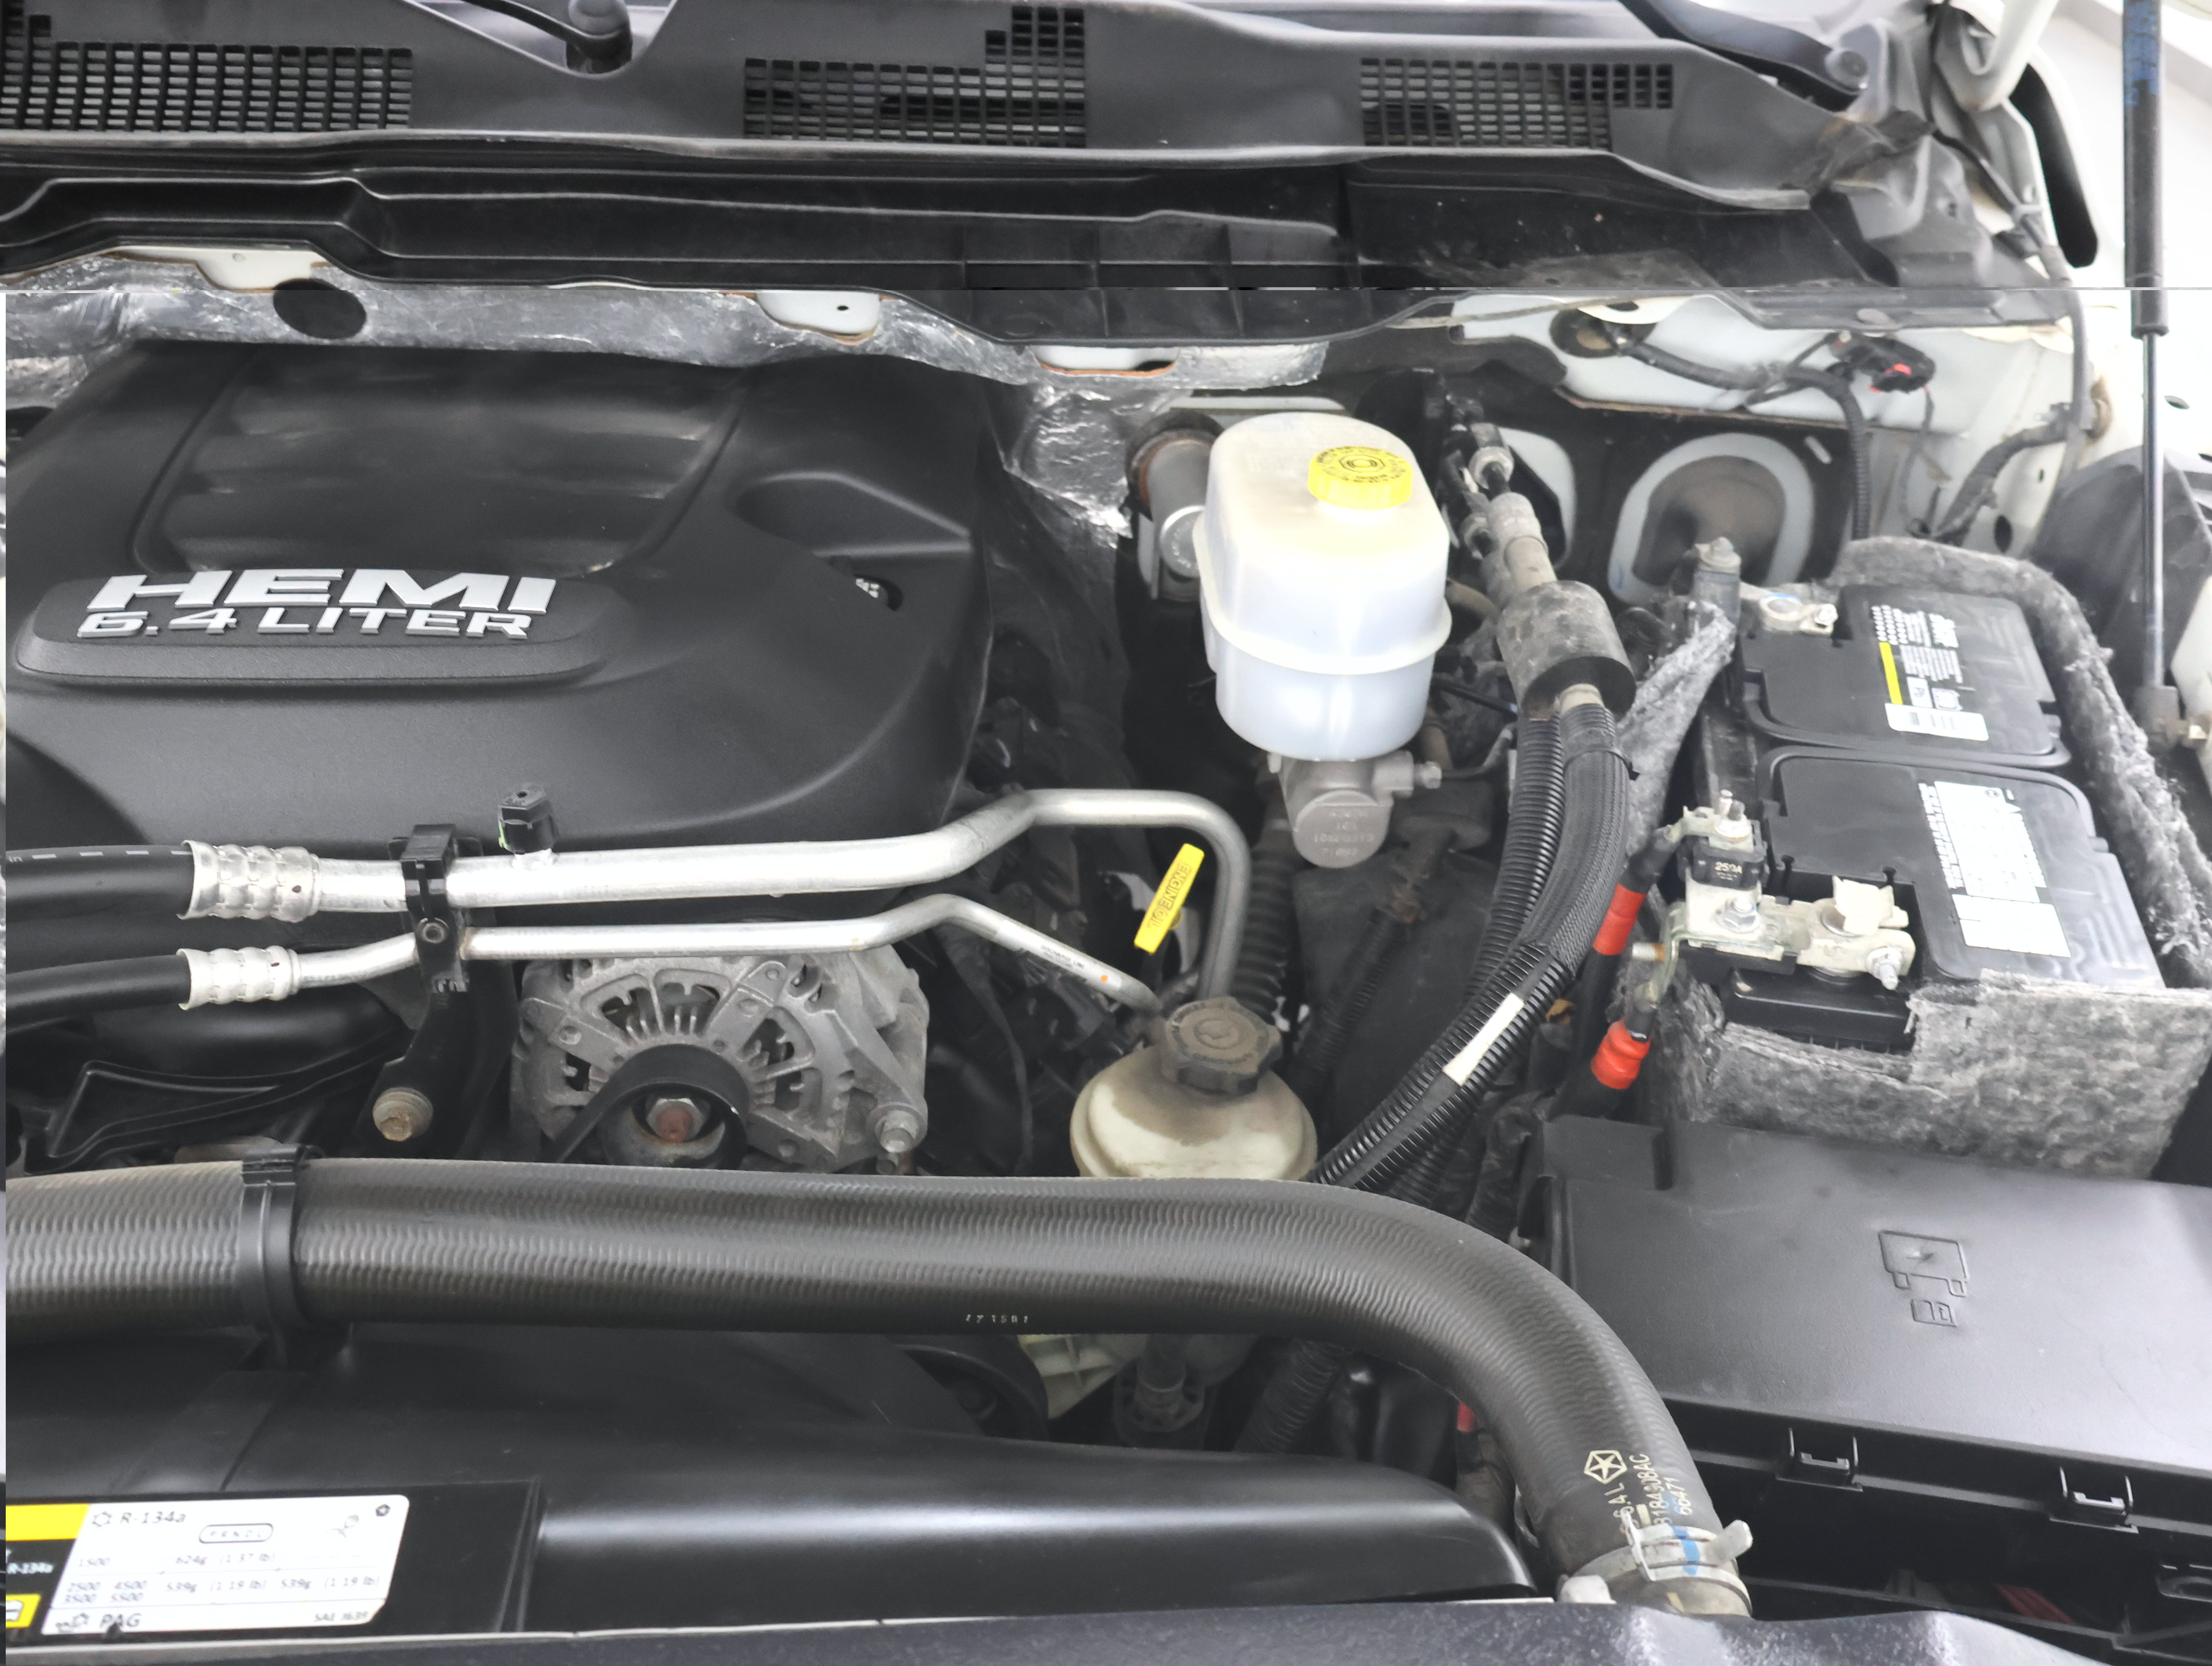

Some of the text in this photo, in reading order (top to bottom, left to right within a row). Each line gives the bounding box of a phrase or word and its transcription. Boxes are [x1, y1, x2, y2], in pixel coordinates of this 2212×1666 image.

[86, 568, 556, 614] HEMI
[78, 608, 532, 639] 6.4 LITER
[1147, 862, 1193, 929] ENGINE OIL
[120, 1511, 186, 1524] R-134a
[99, 1612, 142, 1628] PAG
